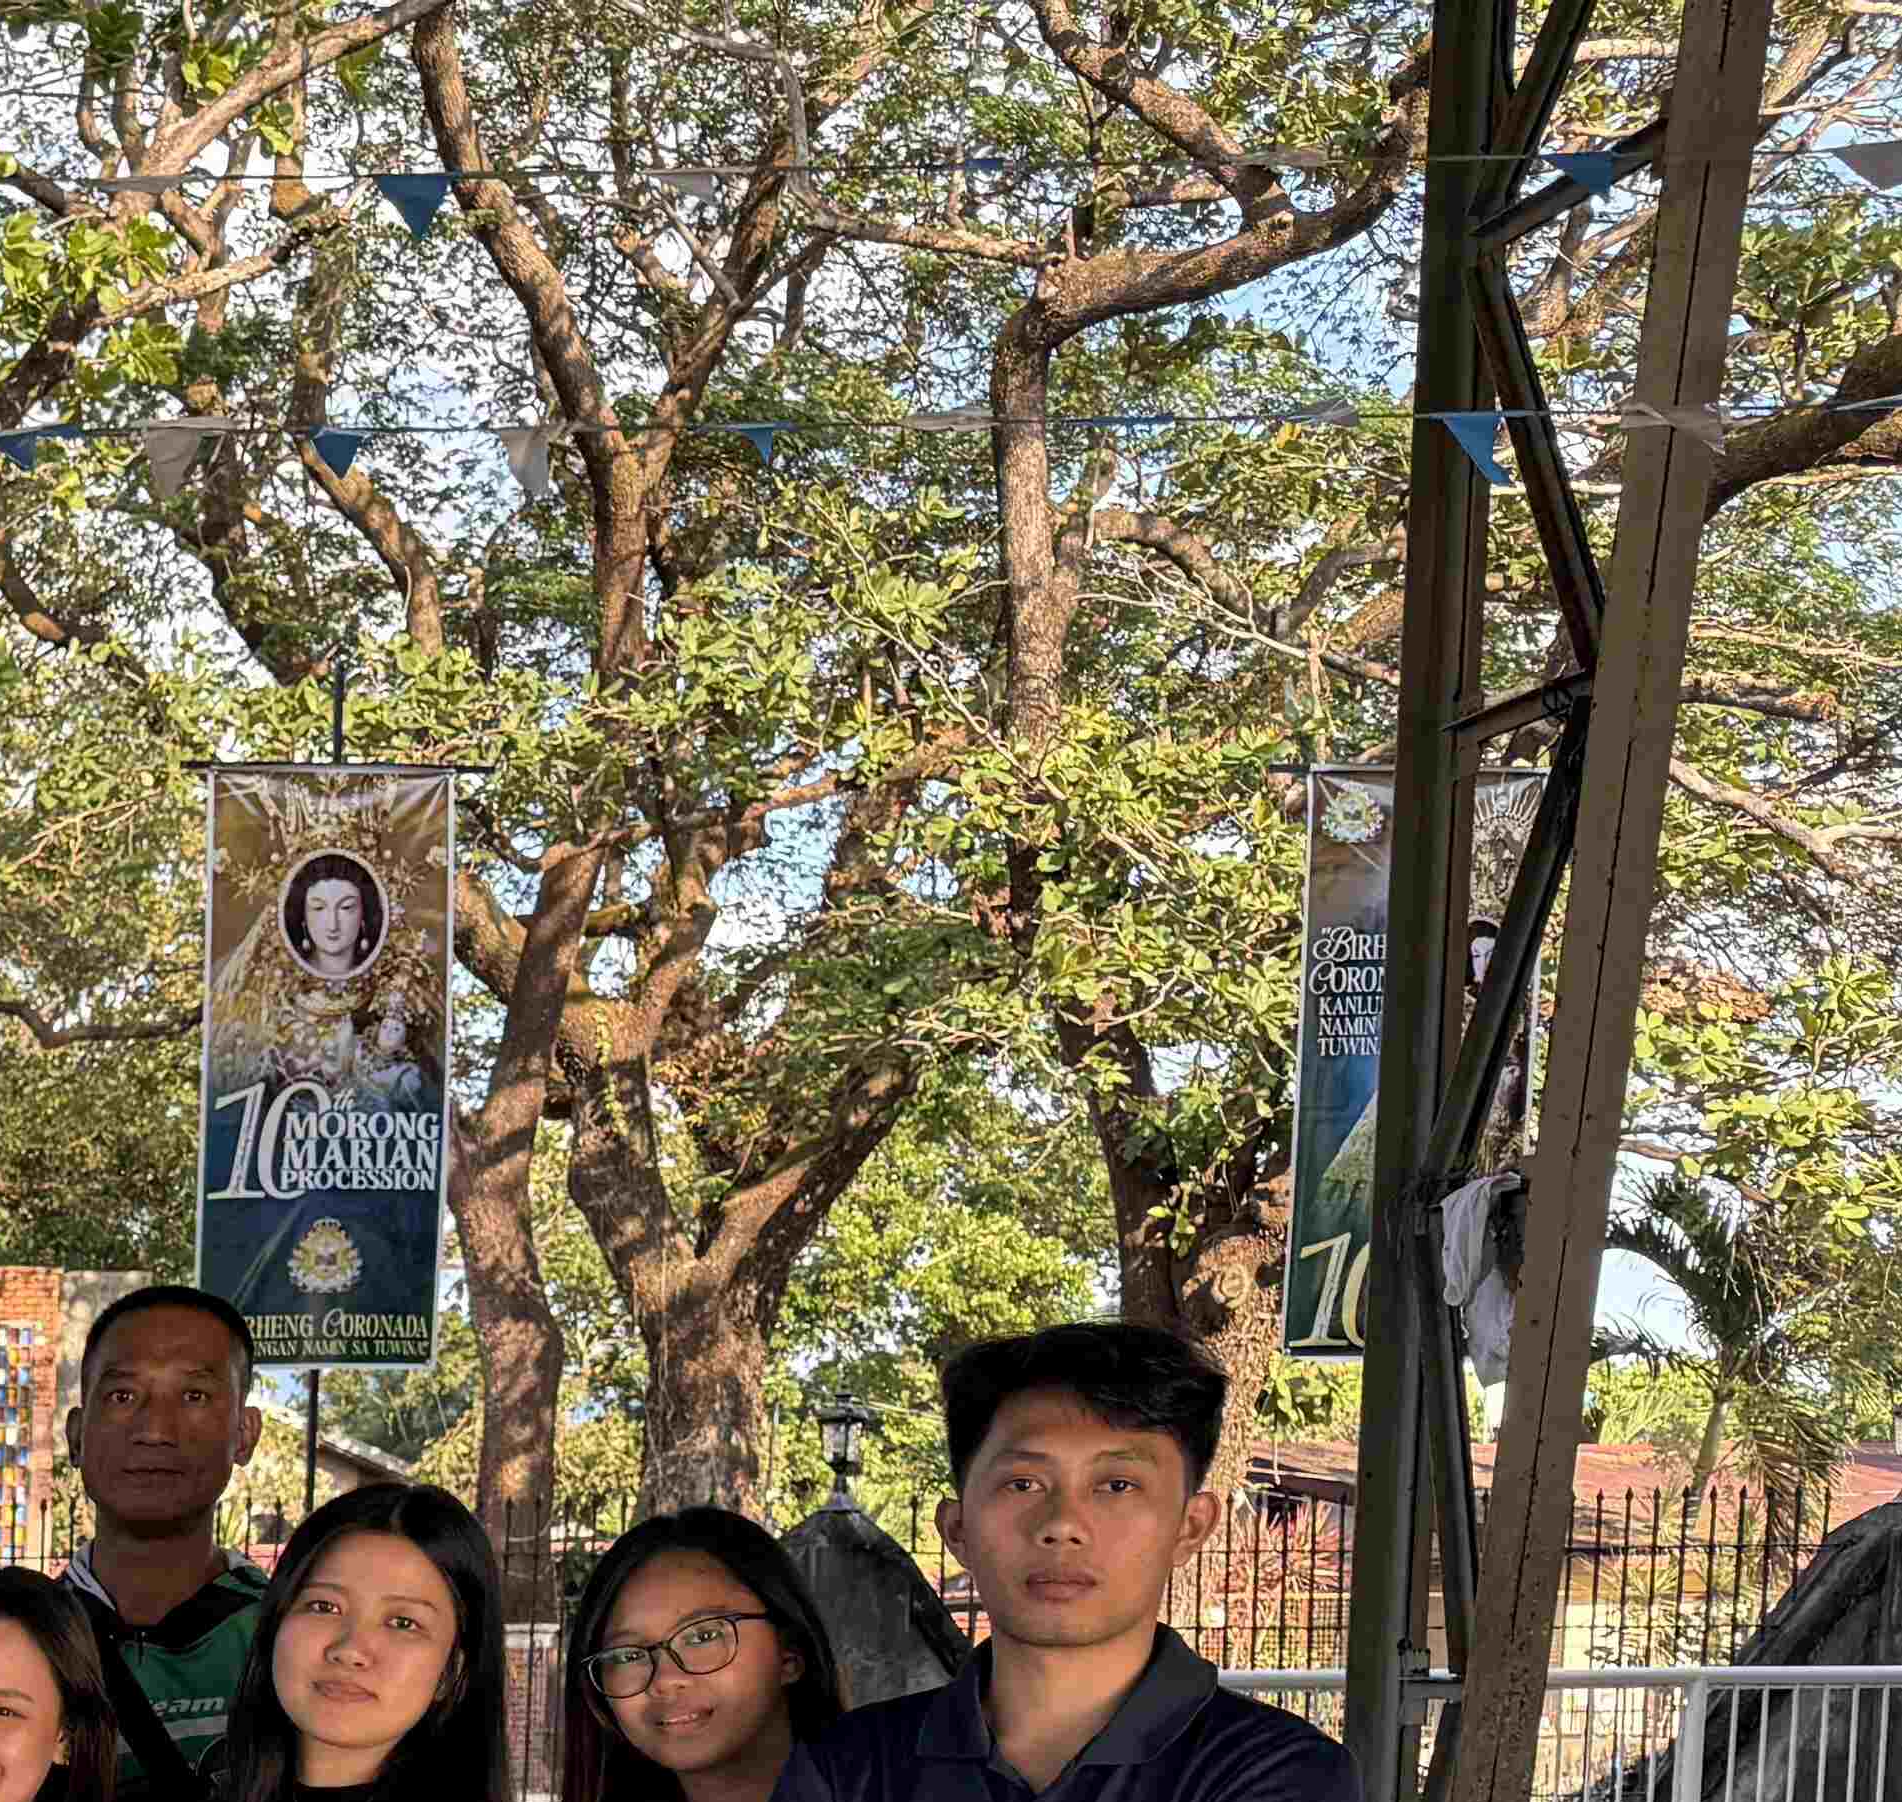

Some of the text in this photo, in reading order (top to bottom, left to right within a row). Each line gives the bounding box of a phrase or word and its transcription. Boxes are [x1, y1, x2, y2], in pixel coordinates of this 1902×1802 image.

[1312, 926, 1387, 962] "BIRH
[1318, 995, 1383, 1016] KANLU
[1318, 1015, 1377, 1036] NAMIN
[1316, 1036, 1381, 1057] TUWIN
[283, 1111, 440, 1142] MORONG
[283, 1138, 438, 1171] MARIAN
[280, 1168, 436, 1192] PROCESSION
[244, 1308, 430, 1340] RHENG CORONADA
